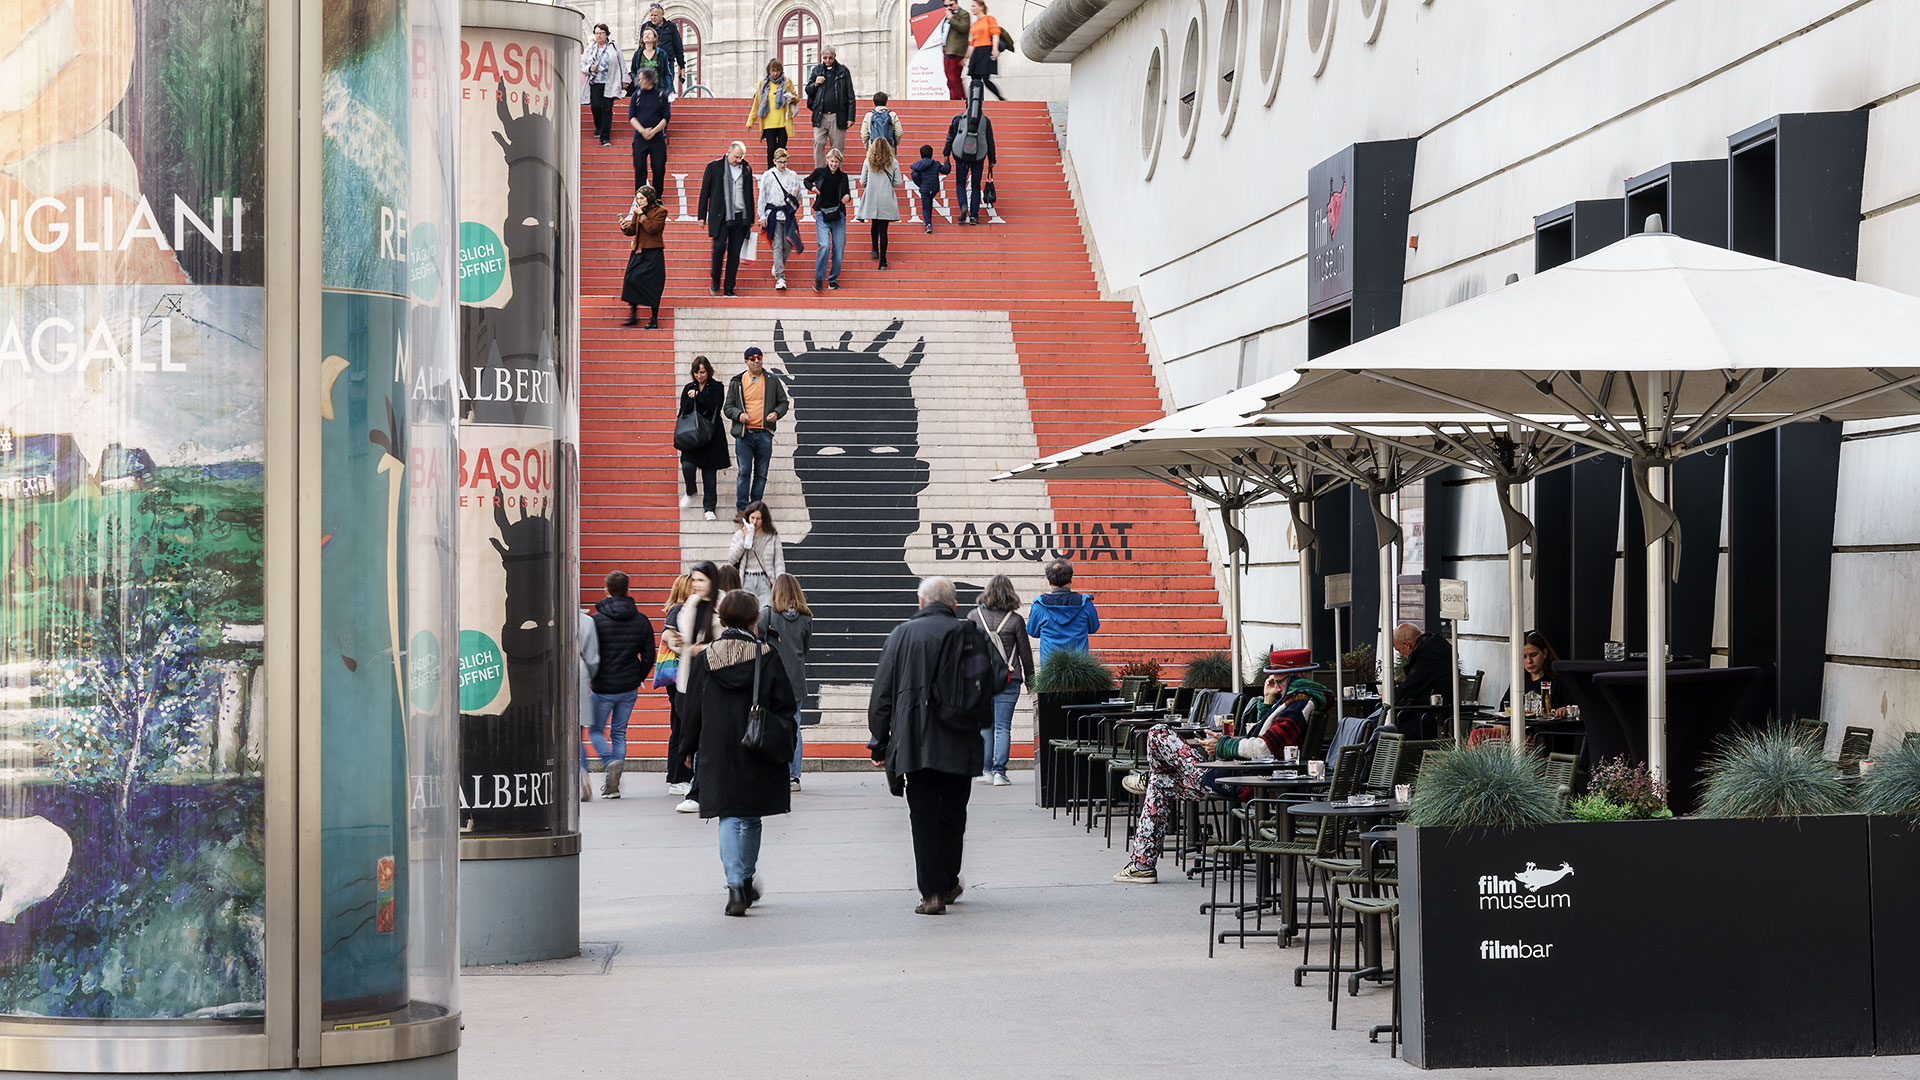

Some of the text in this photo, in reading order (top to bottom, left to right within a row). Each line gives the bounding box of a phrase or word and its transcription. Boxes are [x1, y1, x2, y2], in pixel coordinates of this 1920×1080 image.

[0, 193, 242, 254] IGLIANI
[0, 316, 187, 373] AGALL
[931, 522, 1133, 562] BASQUIAT
[1478, 875, 1517, 894] film
[1480, 893, 1571, 910] museum
[1480, 940, 1554, 960] filmbar
